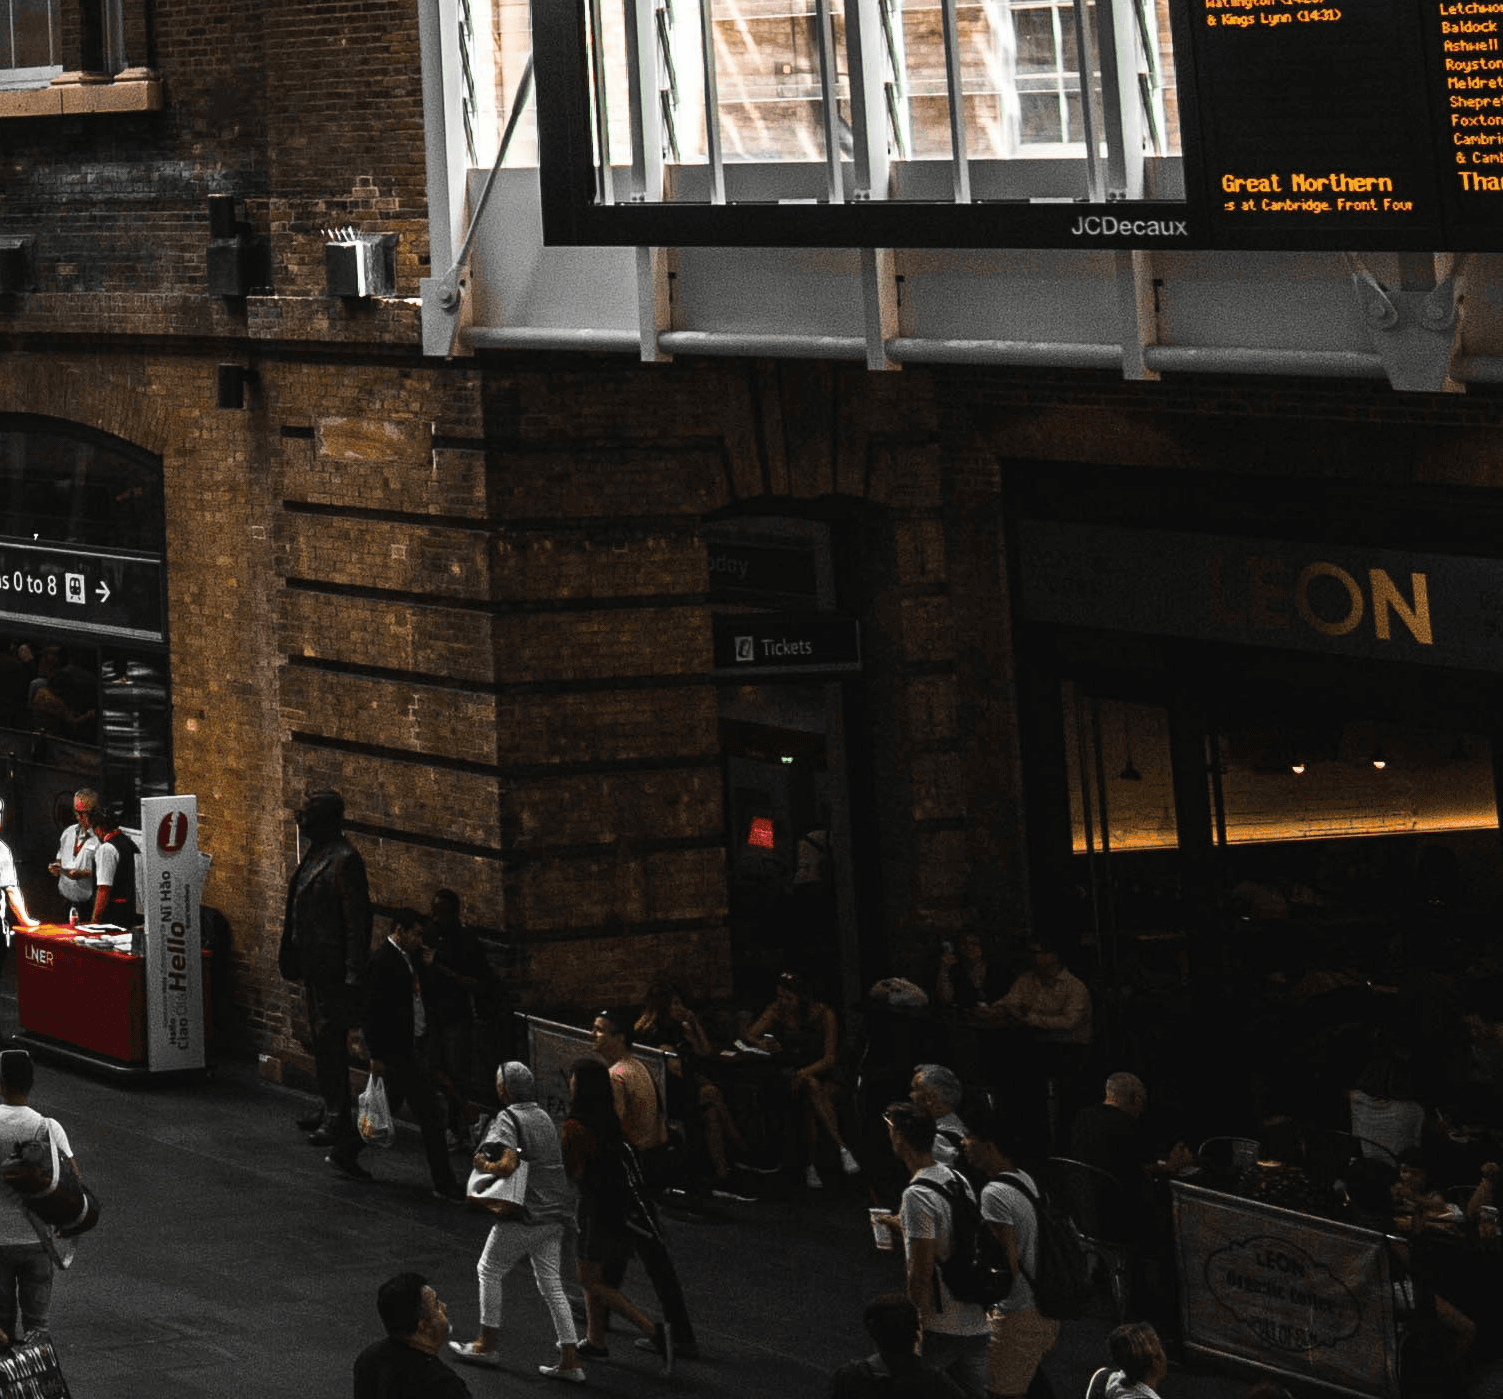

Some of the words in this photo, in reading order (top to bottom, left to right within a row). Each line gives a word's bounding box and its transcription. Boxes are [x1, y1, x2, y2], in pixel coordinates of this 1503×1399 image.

[1207, 14, 1217, 27] &
[1221, 13, 1255, 28] Kings
[1260, 11, 1292, 27] Lynn
[1442, 20, 1497, 34] Baldock
[1444, 38, 1498, 52] Ashwell
[1445, 58, 1503, 73] Royston
[1451, 113, 1503, 127] Foxton
[1454, 131, 1503, 146] Cambri
[1456, 151, 1466, 164] &
[1222, 173, 1282, 193] Great
[1292, 173, 1393, 193] Northern
[1241, 199, 1256, 211] at
[1337, 198, 1377, 211] Front
[1071, 216, 1188, 236] JCDecaux
[13, 570, 23, 592] 0
[27, 574, 43, 594] to
[48, 575, 57, 596] 8
[1208, 554, 1434, 646] LEON
[760, 638, 814, 657] Tickets
[25, 944, 54, 966] LNER
[167, 921, 187, 992] Hello
[177, 1017, 189, 1051] Ciao
